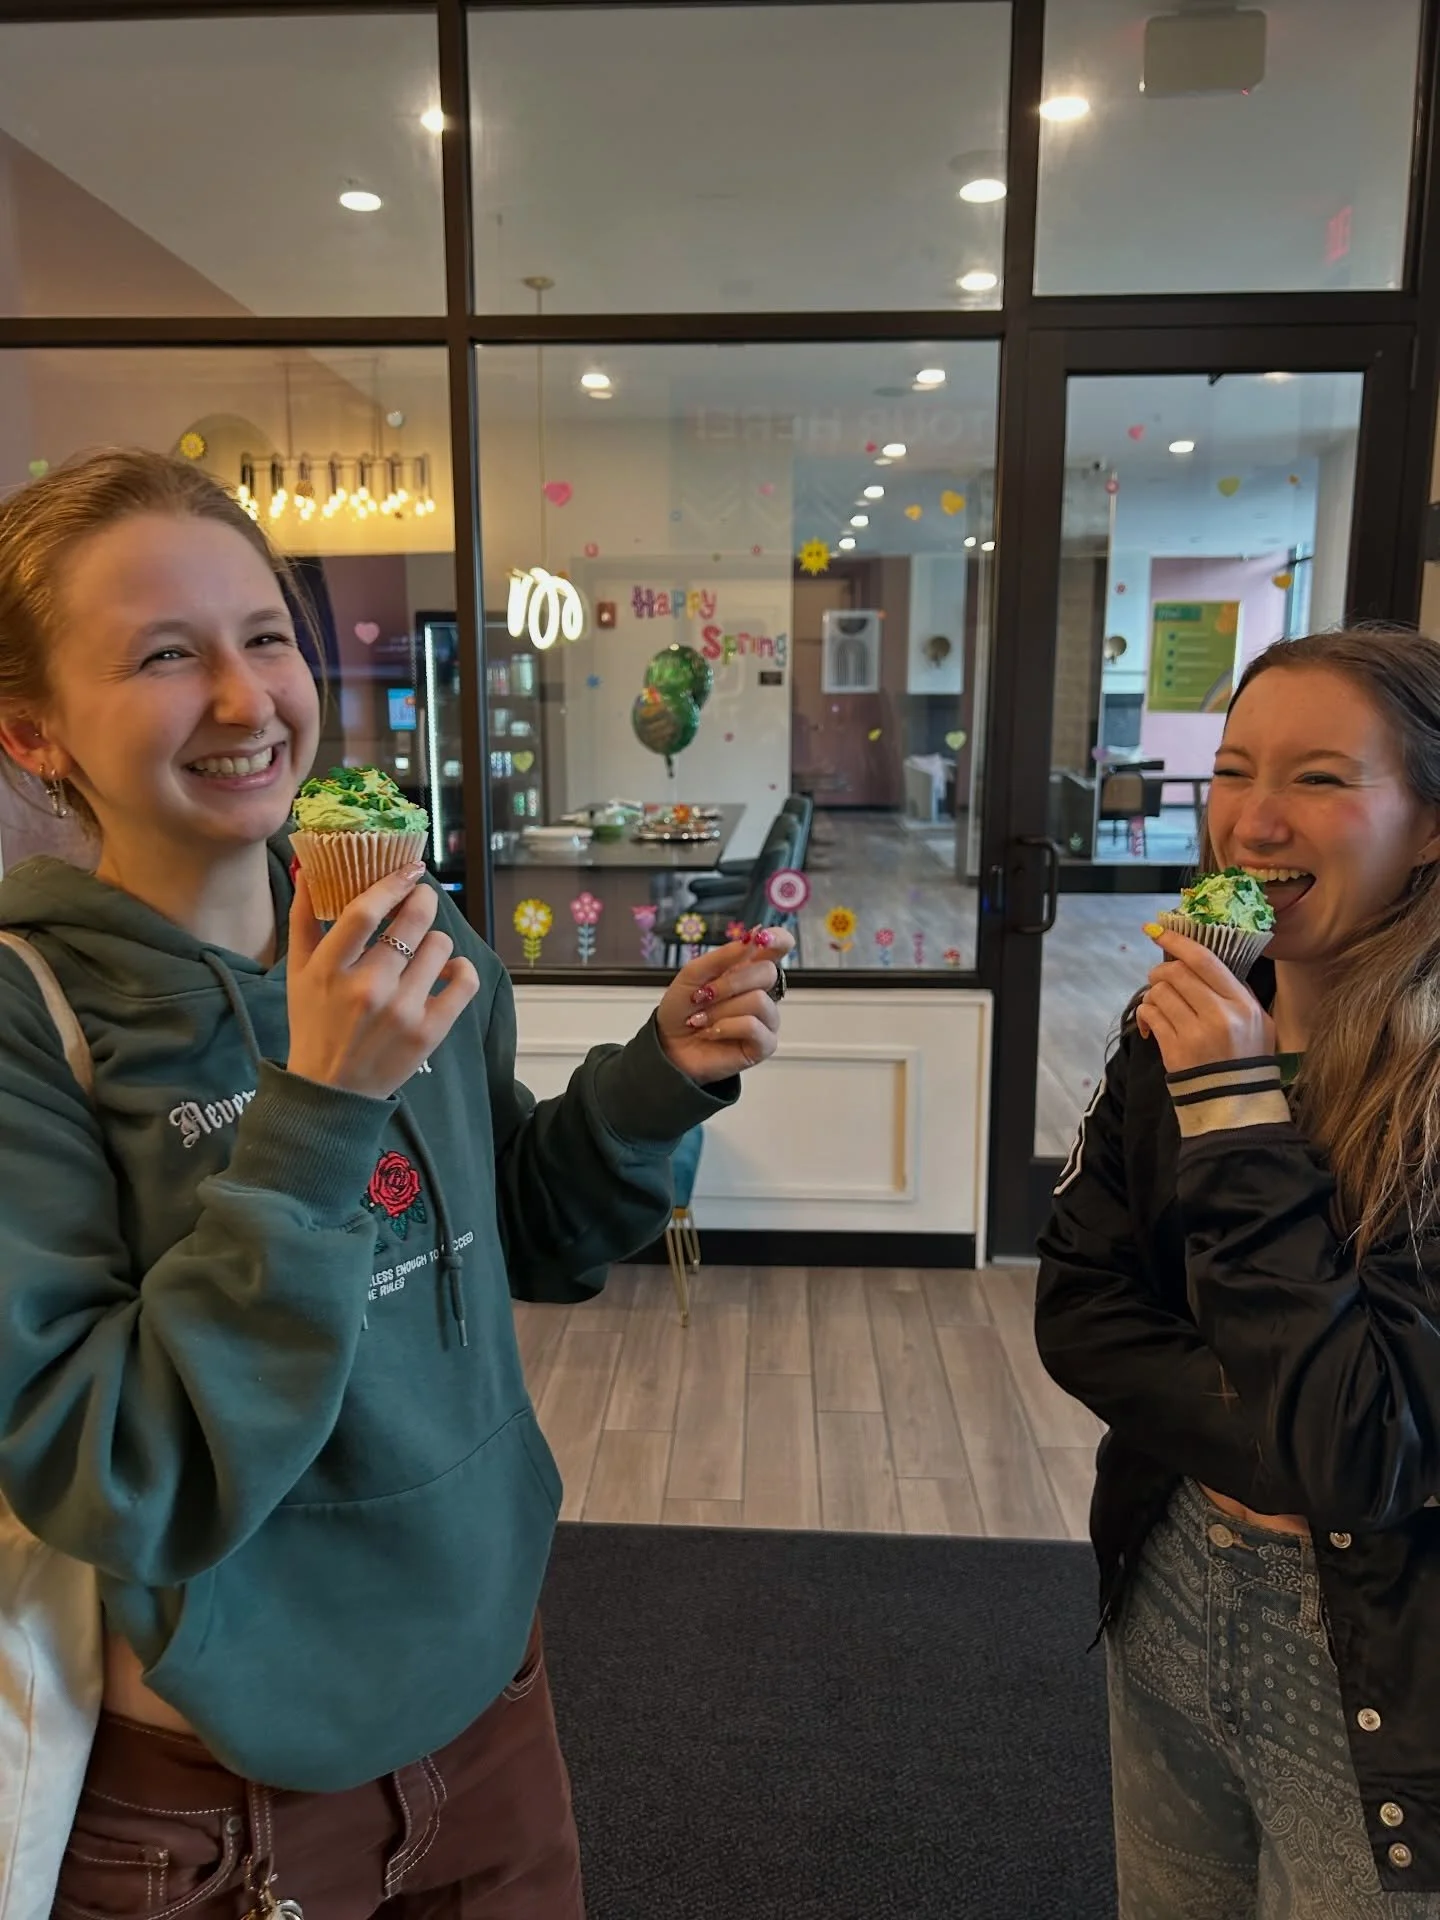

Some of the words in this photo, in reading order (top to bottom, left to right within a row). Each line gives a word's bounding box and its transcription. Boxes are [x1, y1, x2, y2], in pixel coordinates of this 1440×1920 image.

[632, 585, 717, 619] Happy
[702, 624, 787, 666] Spring
[369, 1268, 393, 1287] LESS
[396, 1254, 427, 1277] ENOUGH
[429, 1249, 440, 1262] TO
[380, 1276, 405, 1296] RULES
